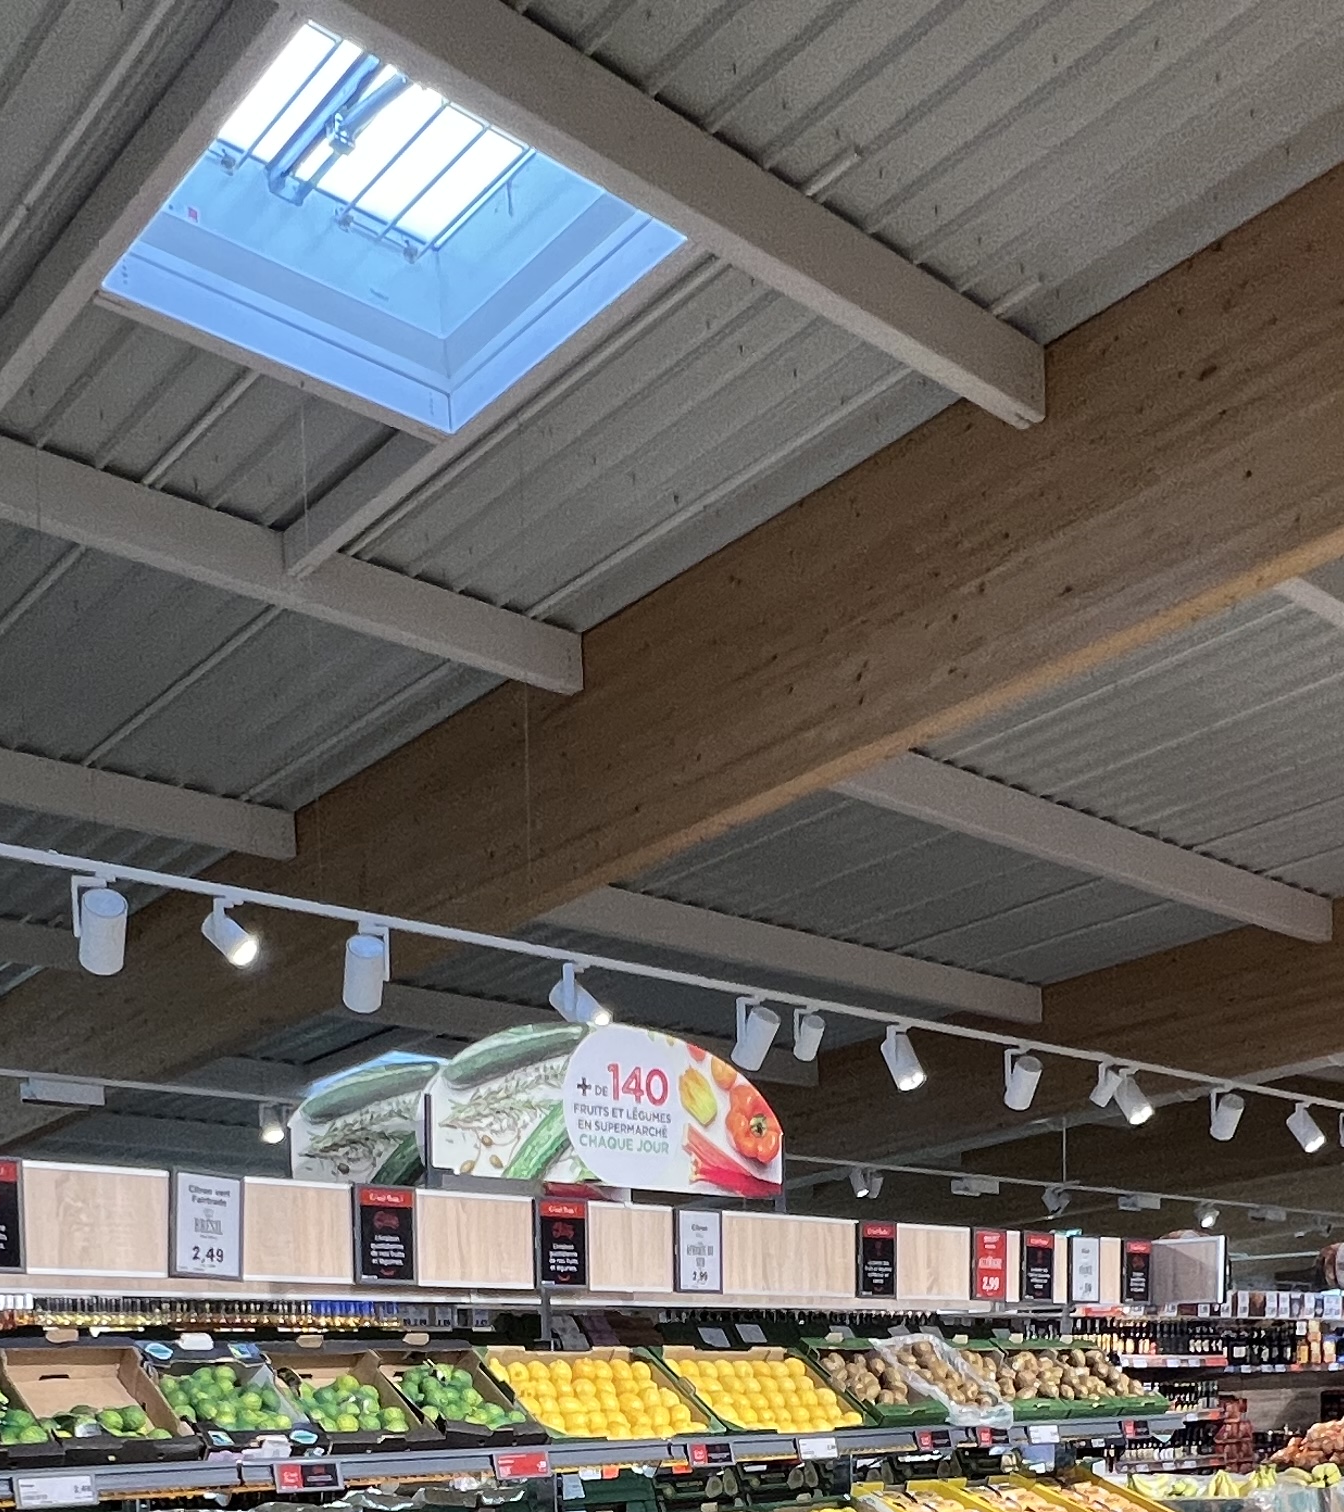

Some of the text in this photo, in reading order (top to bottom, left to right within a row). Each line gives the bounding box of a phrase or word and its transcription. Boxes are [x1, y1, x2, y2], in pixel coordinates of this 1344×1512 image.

[595, 1085, 609, 1097] DE
[607, 1063, 669, 1106] 140
[574, 1103, 672, 1124] FRUITS ET LÉGUMES
[578, 1119, 668, 1138] EN SUPERMARCHÉ
[580, 1134, 670, 1155] CHAQUE JOUR
[192, 1246, 224, 1263] 2,49
